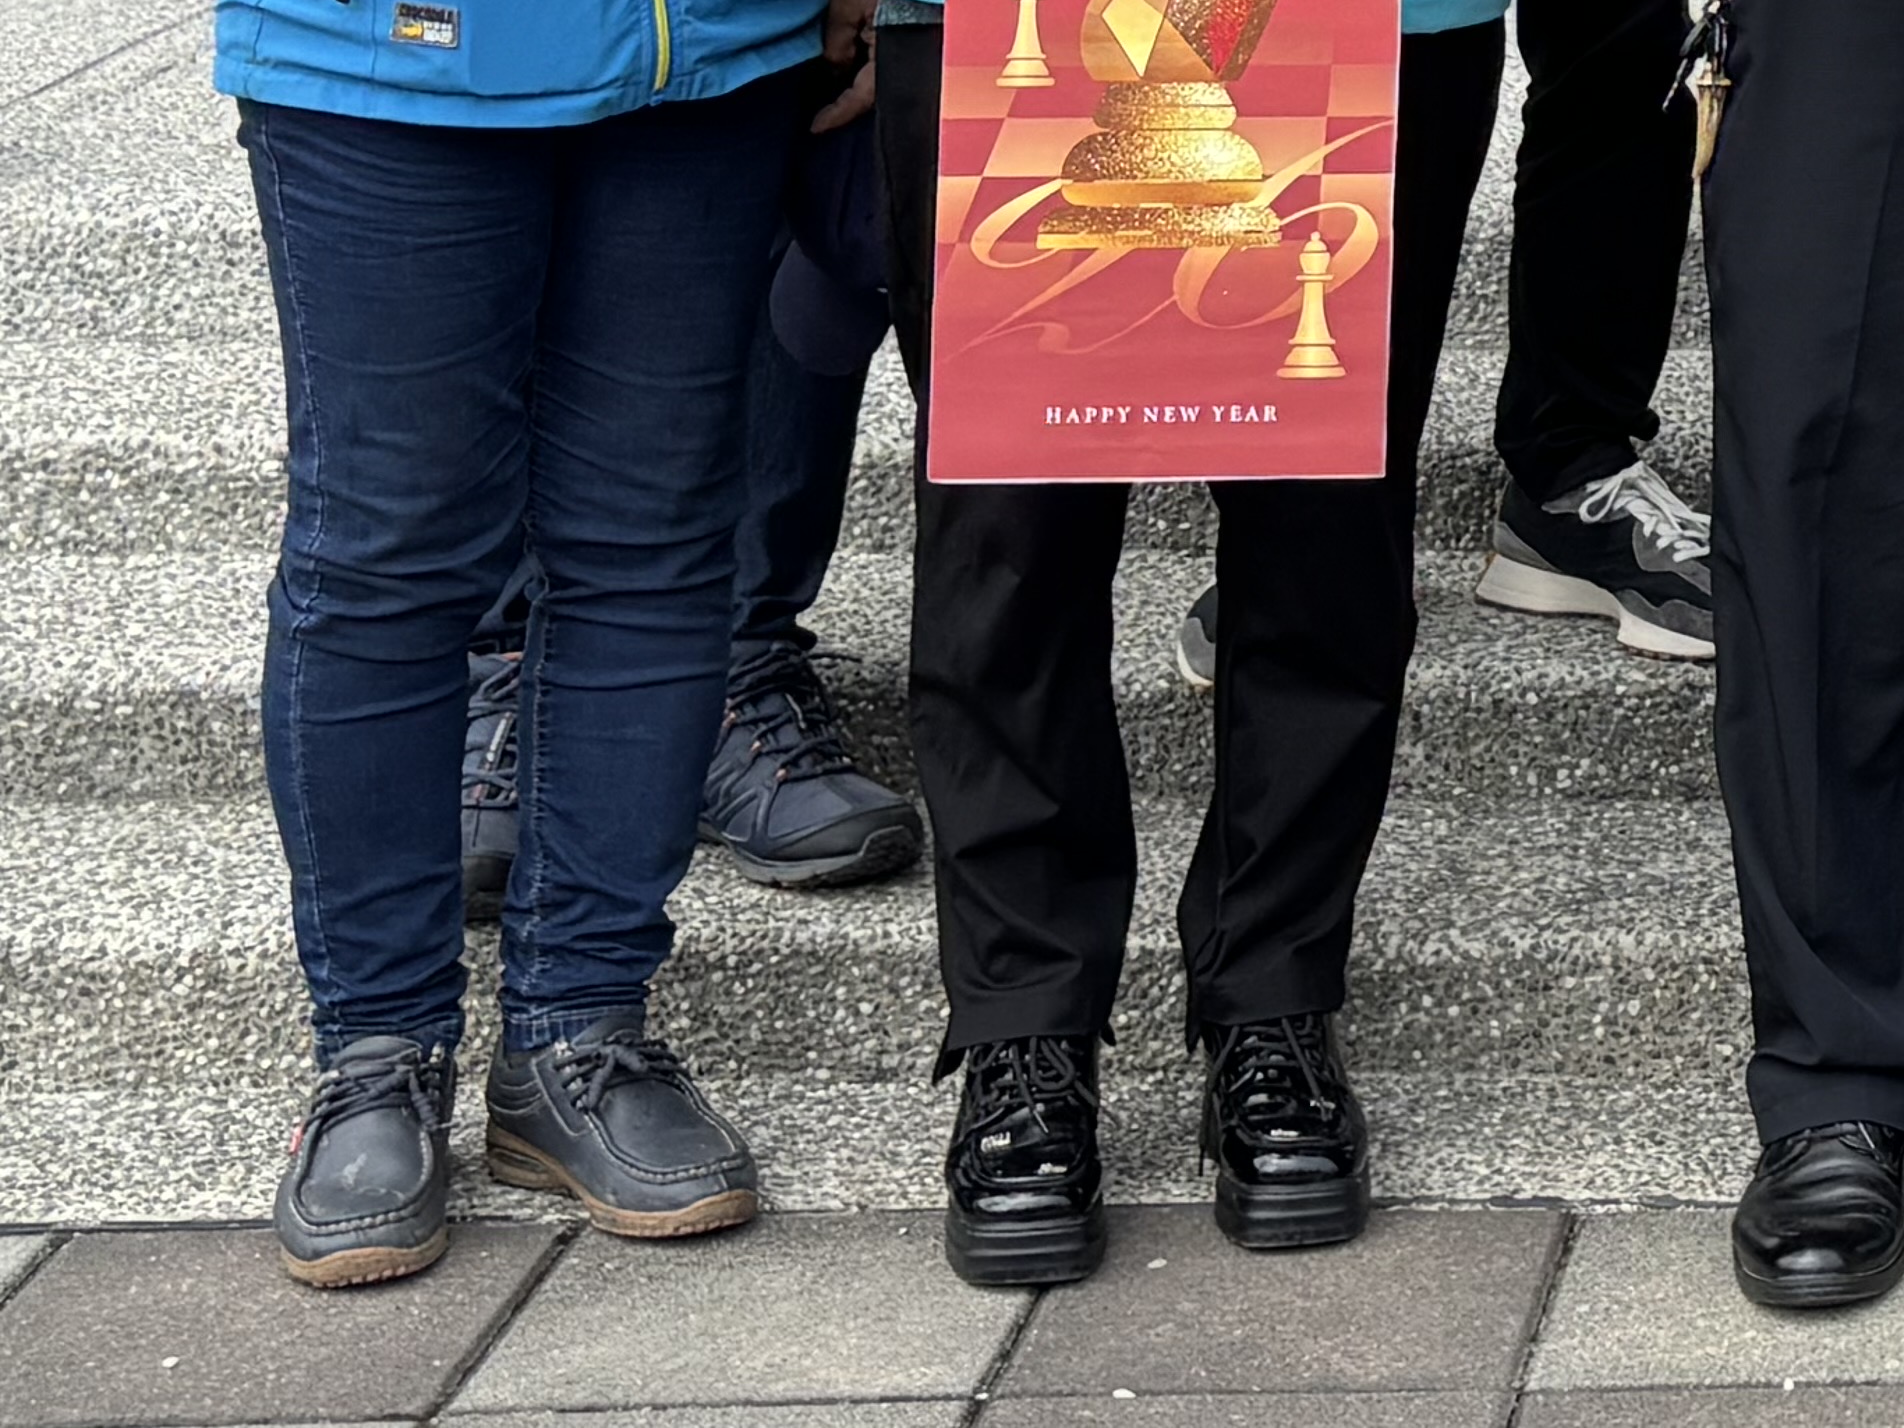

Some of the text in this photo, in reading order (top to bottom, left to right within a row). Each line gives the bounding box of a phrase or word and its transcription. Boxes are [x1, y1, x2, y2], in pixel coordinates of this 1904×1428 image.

[1045, 404, 1279, 425] HAPPY NEW YEAR
